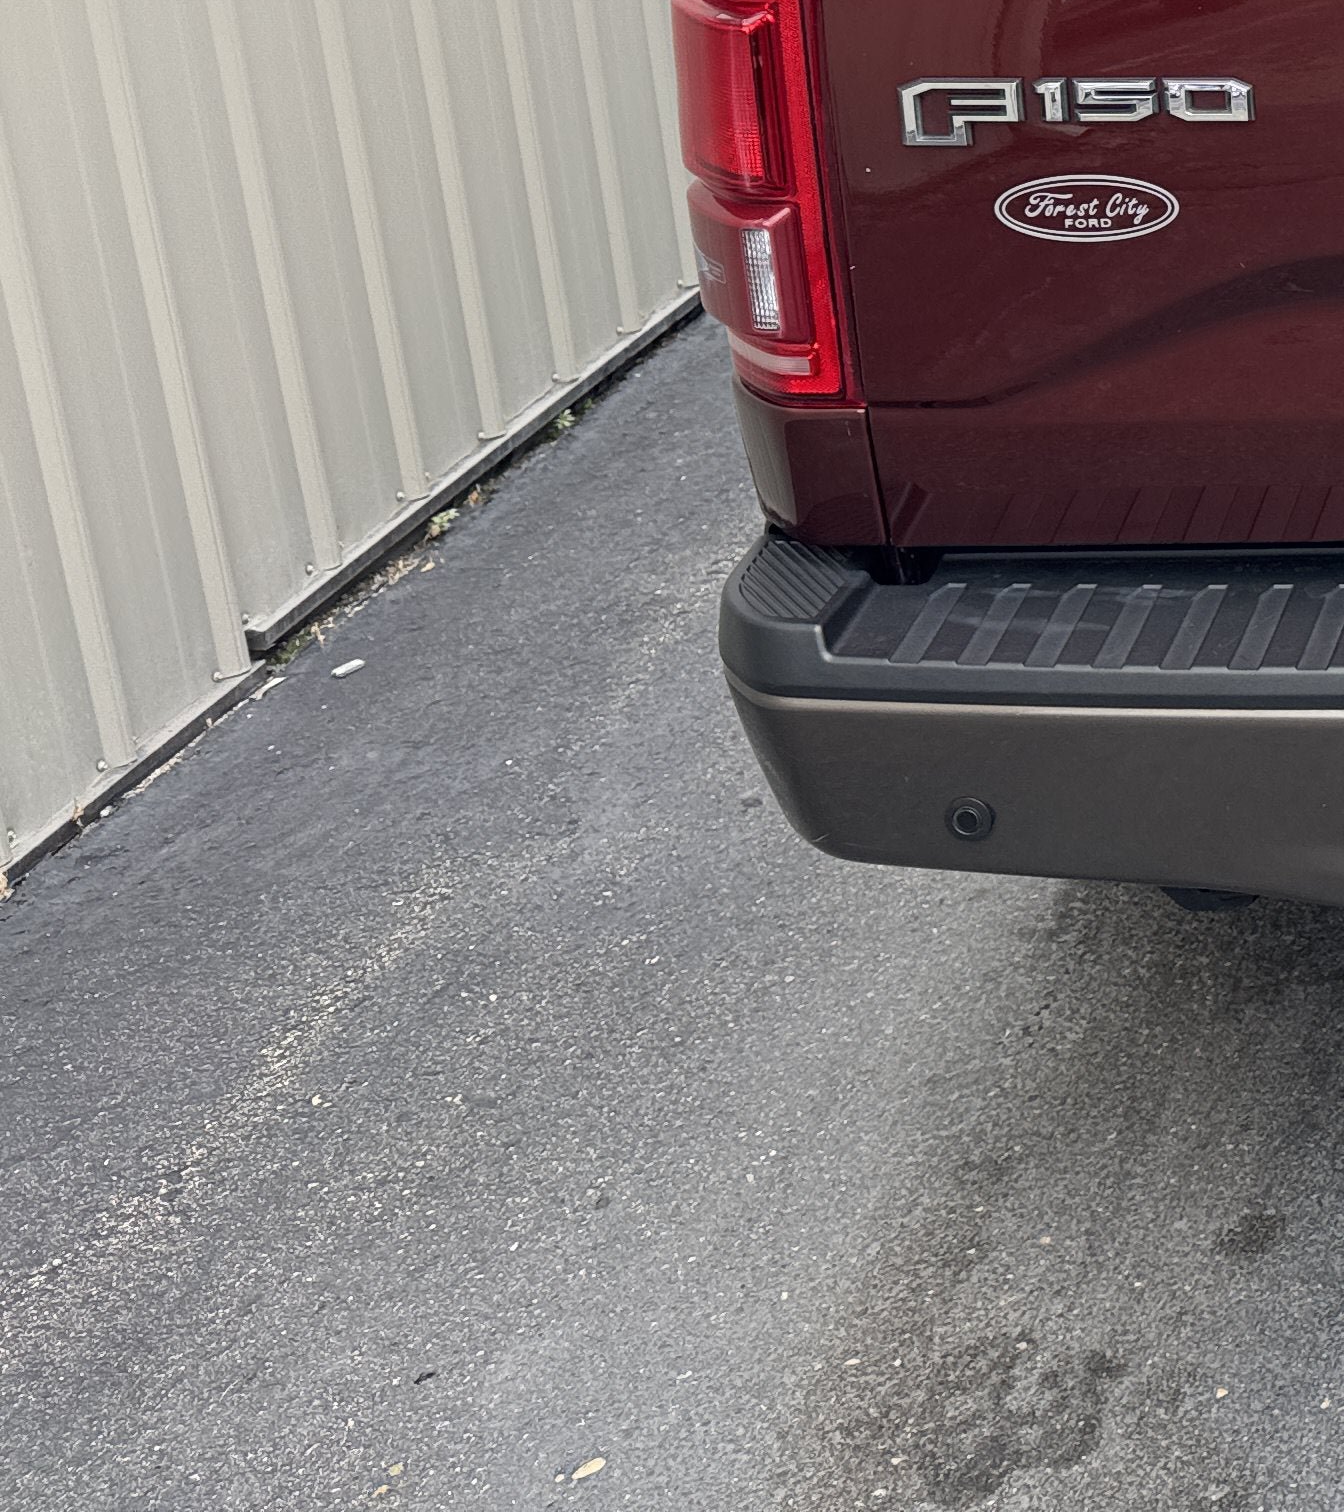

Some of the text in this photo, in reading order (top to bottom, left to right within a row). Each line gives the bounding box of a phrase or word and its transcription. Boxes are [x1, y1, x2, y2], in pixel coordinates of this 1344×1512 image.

[1024, 192, 1150, 224] Forest City
[1064, 217, 1112, 229] FORD
